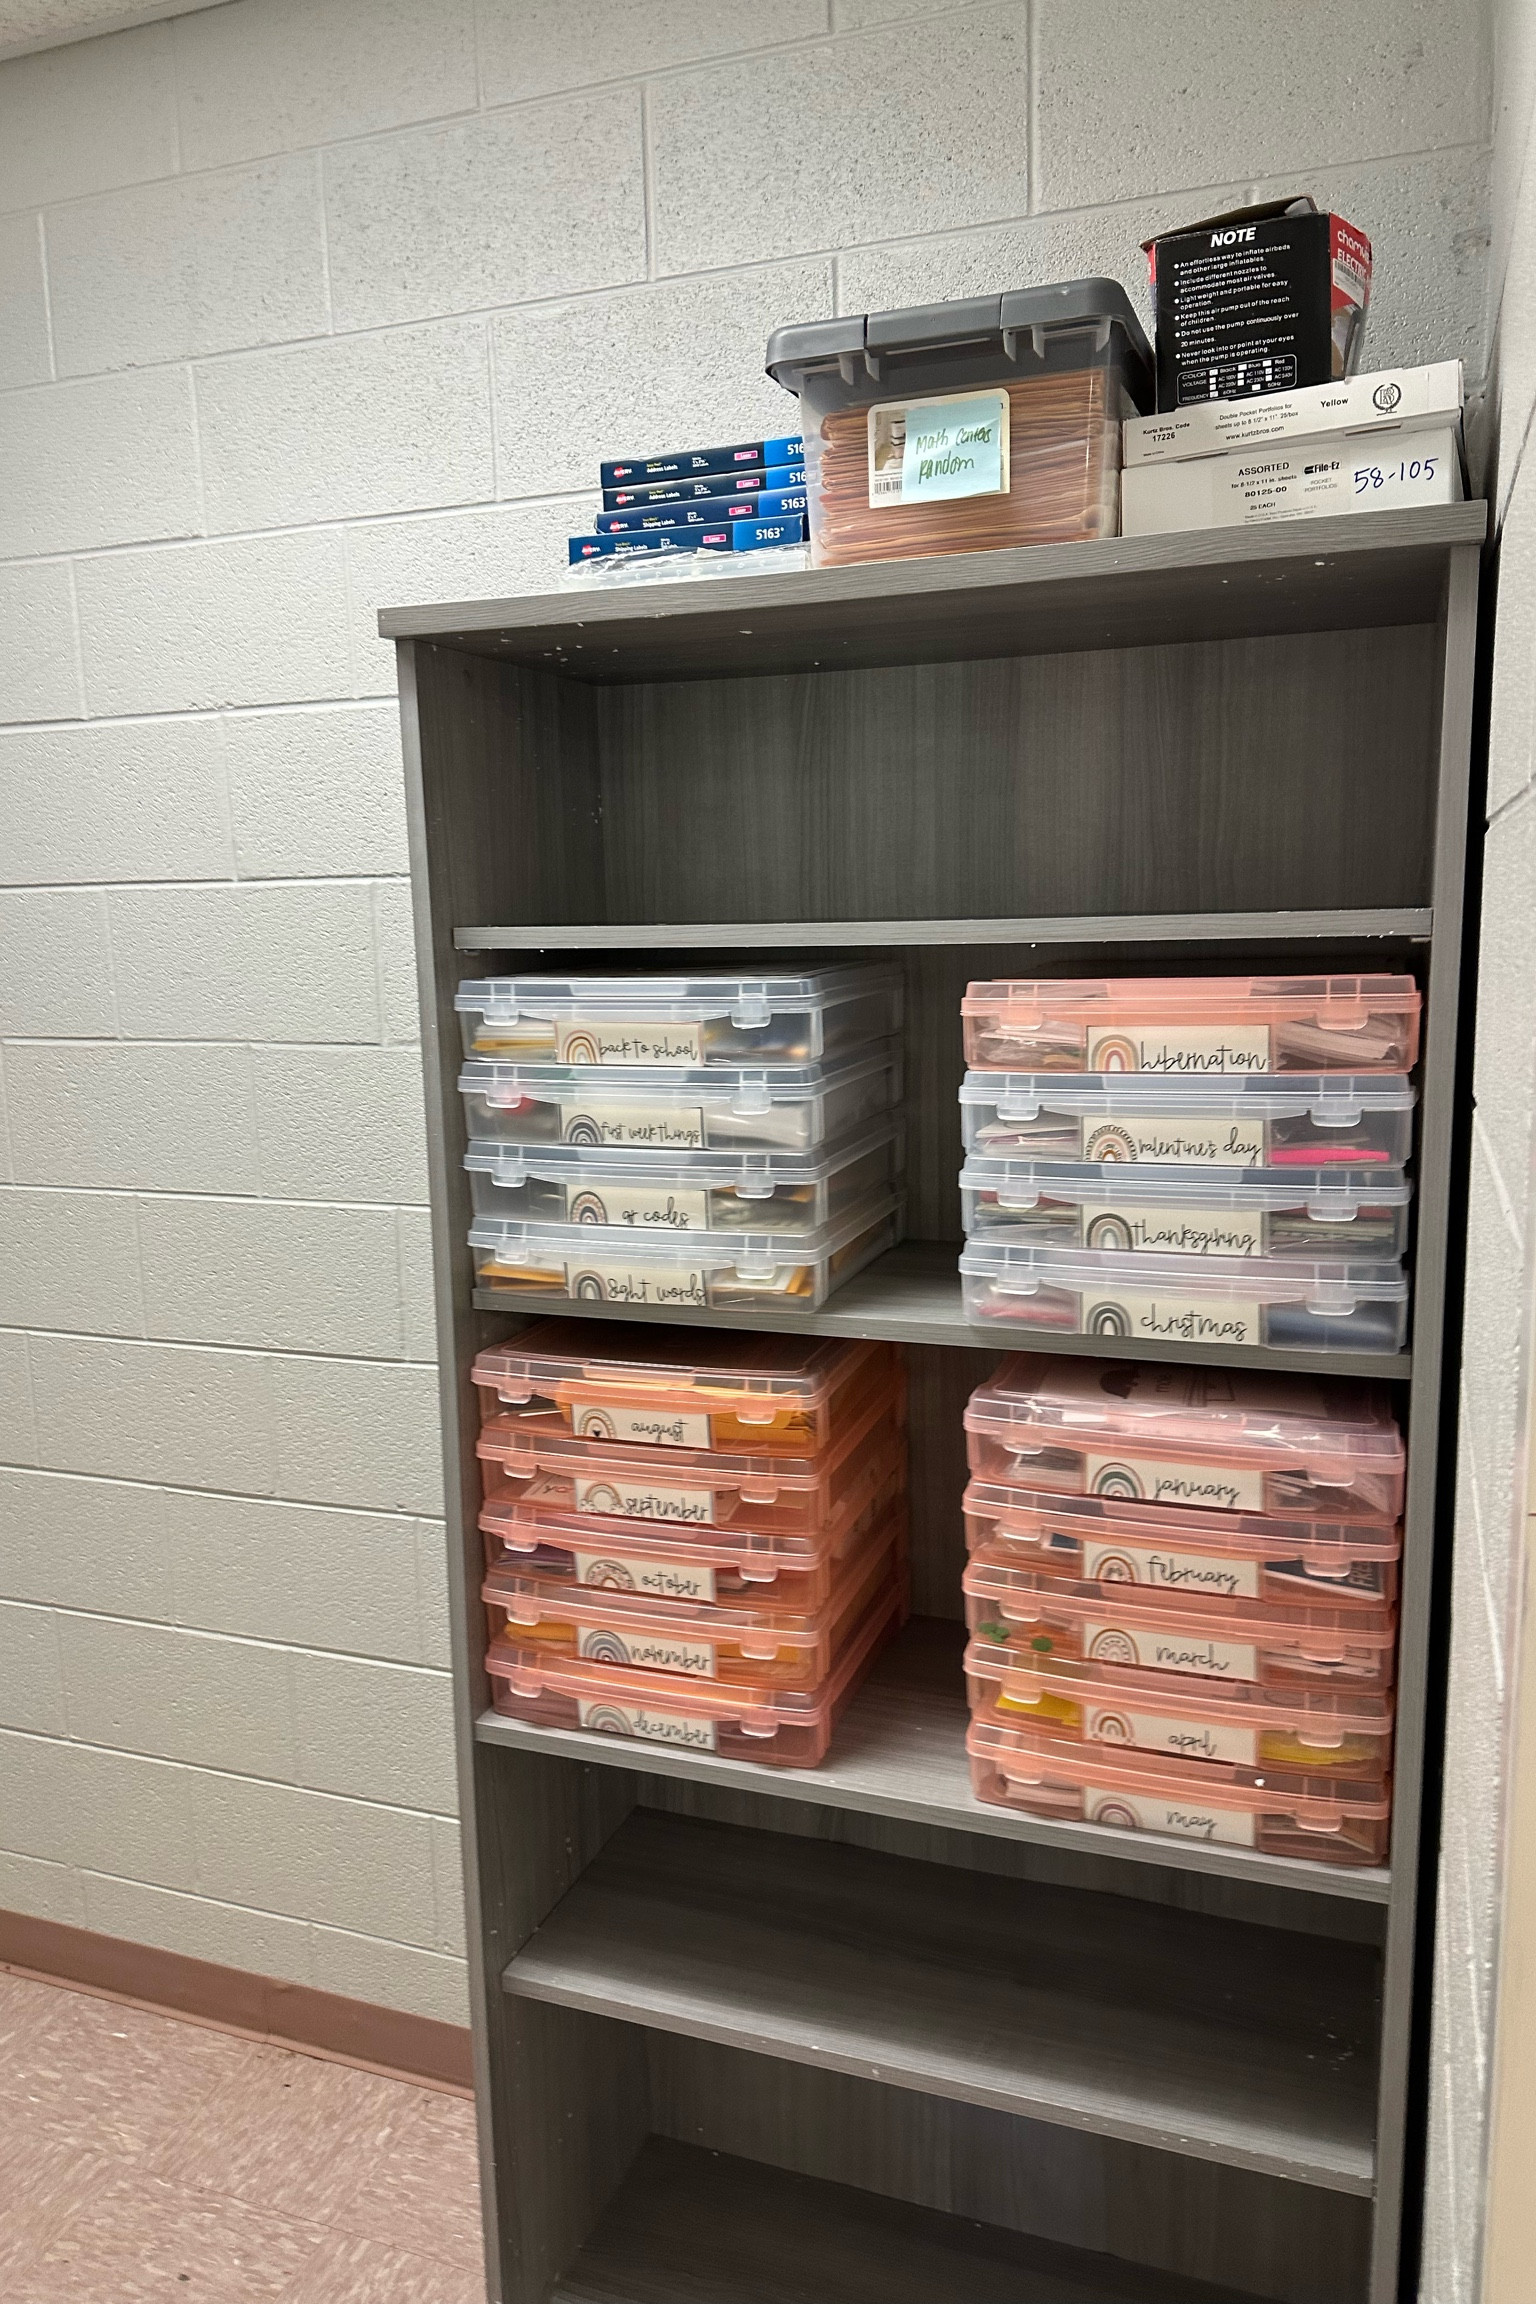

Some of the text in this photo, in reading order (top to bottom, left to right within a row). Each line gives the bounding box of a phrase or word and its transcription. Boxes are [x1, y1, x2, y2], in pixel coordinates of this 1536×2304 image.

[1210, 227, 1256, 248] NOTE
[1190, 256, 1220, 266] effortless
[1229, 257, 1264, 266] inflatables
[1180, 277, 1204, 285] Include
[1205, 271, 1232, 281] different
[1234, 267, 1259, 275] nozzles
[1180, 281, 1225, 293] accommodate
[1180, 295, 1196, 303] Light
[1197, 291, 1218, 299] weight
[1233, 284, 1260, 294] portable
[1221, 305, 1239, 313] pump
[1227, 321, 1244, 329] pump
[1246, 315, 1282, 325] continuously
[1238, 341, 1254, 349] point
[1211, 354, 1228, 362] pump
[1182, 371, 1207, 380] COLOR
[1182, 379, 1207, 388] VOLTAGE
[1321, 398, 1348, 408] Yellow
[916, 428, 949, 454] Math
[1153, 432, 1175, 442] 17226
[1226, 426, 1284, 440] www.kurtzbros.com
[614, 468, 633, 476] AVERY
[1238, 462, 1290, 477] ASSORTED
[1354, 458, 1439, 494] 58-105
[1245, 486, 1287, 498] 80125-00
[1304, 483, 1338, 493] PORTFOLIOS
[642, 520, 661, 528] Shipping
[598, 1036, 698, 1061] back to school
[1140, 1041, 1267, 1073] hibernation
[600, 1122, 700, 1147] first week things
[1222, 1126, 1263, 1167] day
[643, 1196, 690, 1229] codes
[1130, 1218, 1257, 1256] thanksgiving
[607, 1273, 705, 1306] sight words
[1140, 1303, 1249, 1342] christmas
[631, 1419, 689, 1444] august
[1153, 1477, 1241, 1509] january
[625, 1494, 709, 1521] september
[641, 1571, 702, 1596] october
[1146, 1555, 1240, 1596] february
[630, 1644, 711, 1671] november
[1155, 1643, 1230, 1671] march
[632, 1709, 711, 1744] december
[1167, 1730, 1218, 1757] april
[1166, 1810, 1218, 1839] may
